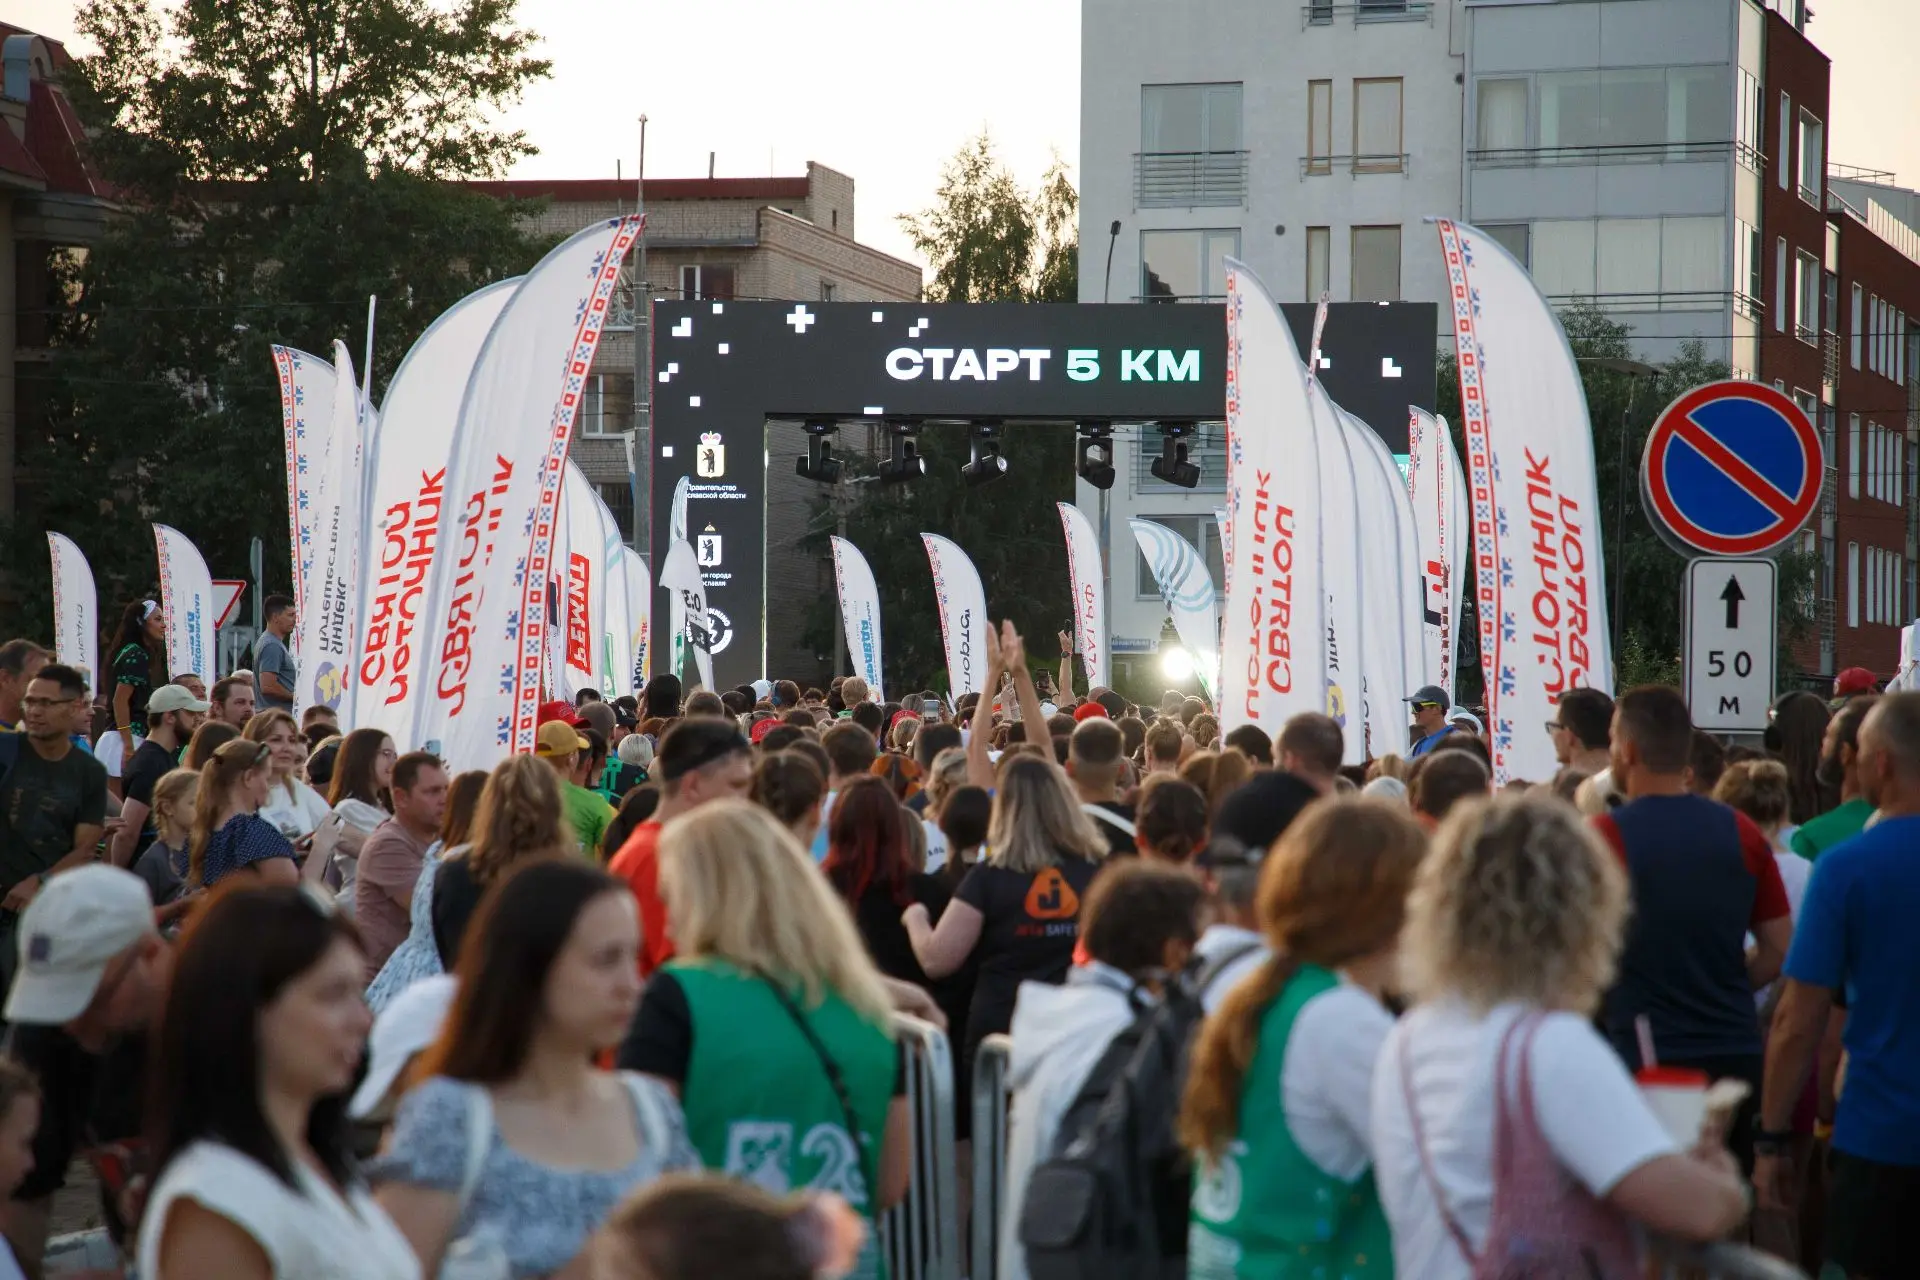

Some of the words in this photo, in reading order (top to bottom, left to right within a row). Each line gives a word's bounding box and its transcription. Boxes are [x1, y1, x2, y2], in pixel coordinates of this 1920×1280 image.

[885, 348, 1051, 381] СТАРТ
[1066, 349, 1099, 381] 5
[1121, 349, 1200, 381] КМ
[1707, 651, 1752, 678] 50
